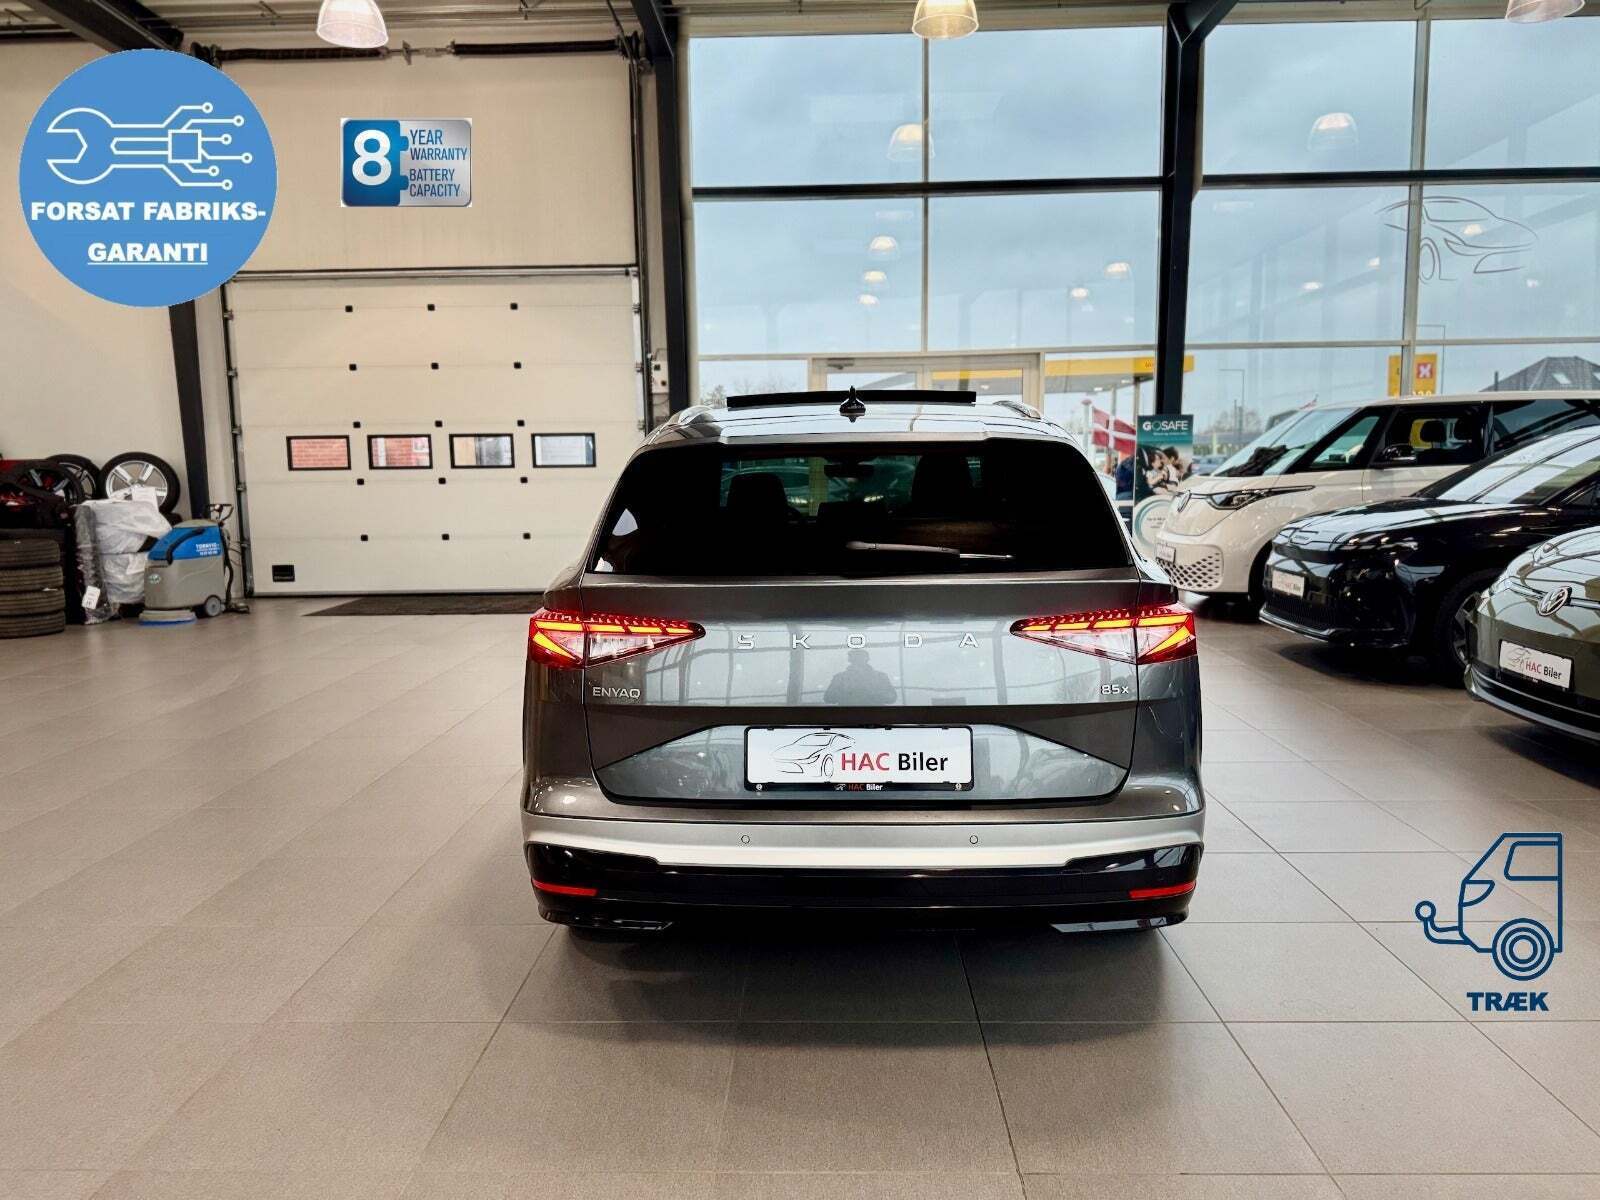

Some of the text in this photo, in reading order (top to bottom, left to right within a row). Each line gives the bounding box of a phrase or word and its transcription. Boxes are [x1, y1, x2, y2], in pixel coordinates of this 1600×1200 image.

[737, 632, 979, 649] SKODA
[1525, 660, 1542, 674] HAC
[1543, 665, 1562, 680] Biler
[592, 686, 641, 699] ENYAQ
[840, 751, 949, 771] HAC Biler
[848, 783, 884, 791] HAC Biler
